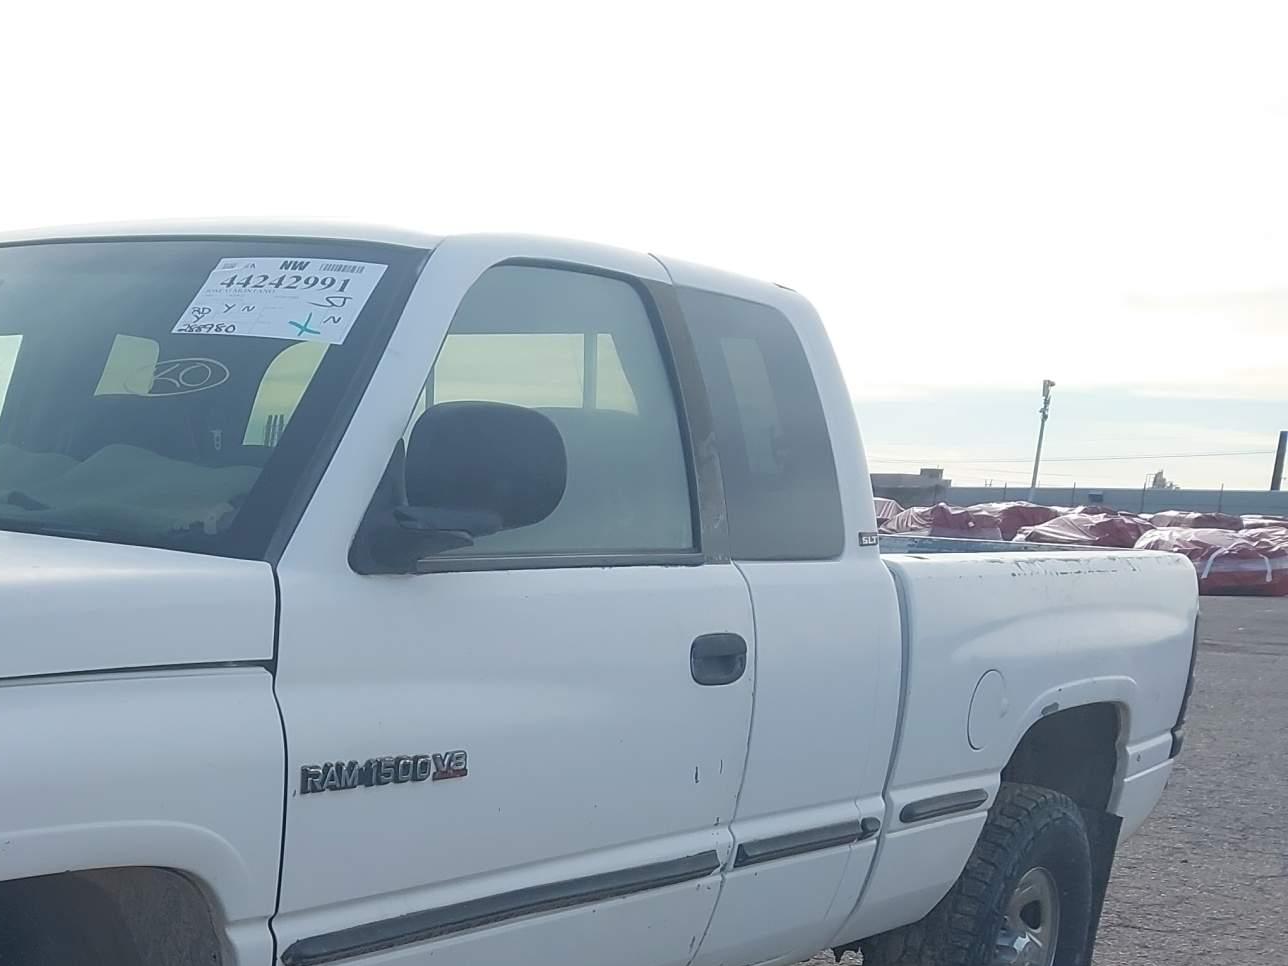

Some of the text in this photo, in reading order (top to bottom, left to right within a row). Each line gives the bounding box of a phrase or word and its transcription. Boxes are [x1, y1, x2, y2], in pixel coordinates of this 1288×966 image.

[279, 260, 311, 271] NW
[220, 273, 352, 292] 44242991
[300, 762, 360, 795] RAM
[361, 754, 431, 788] 1500
